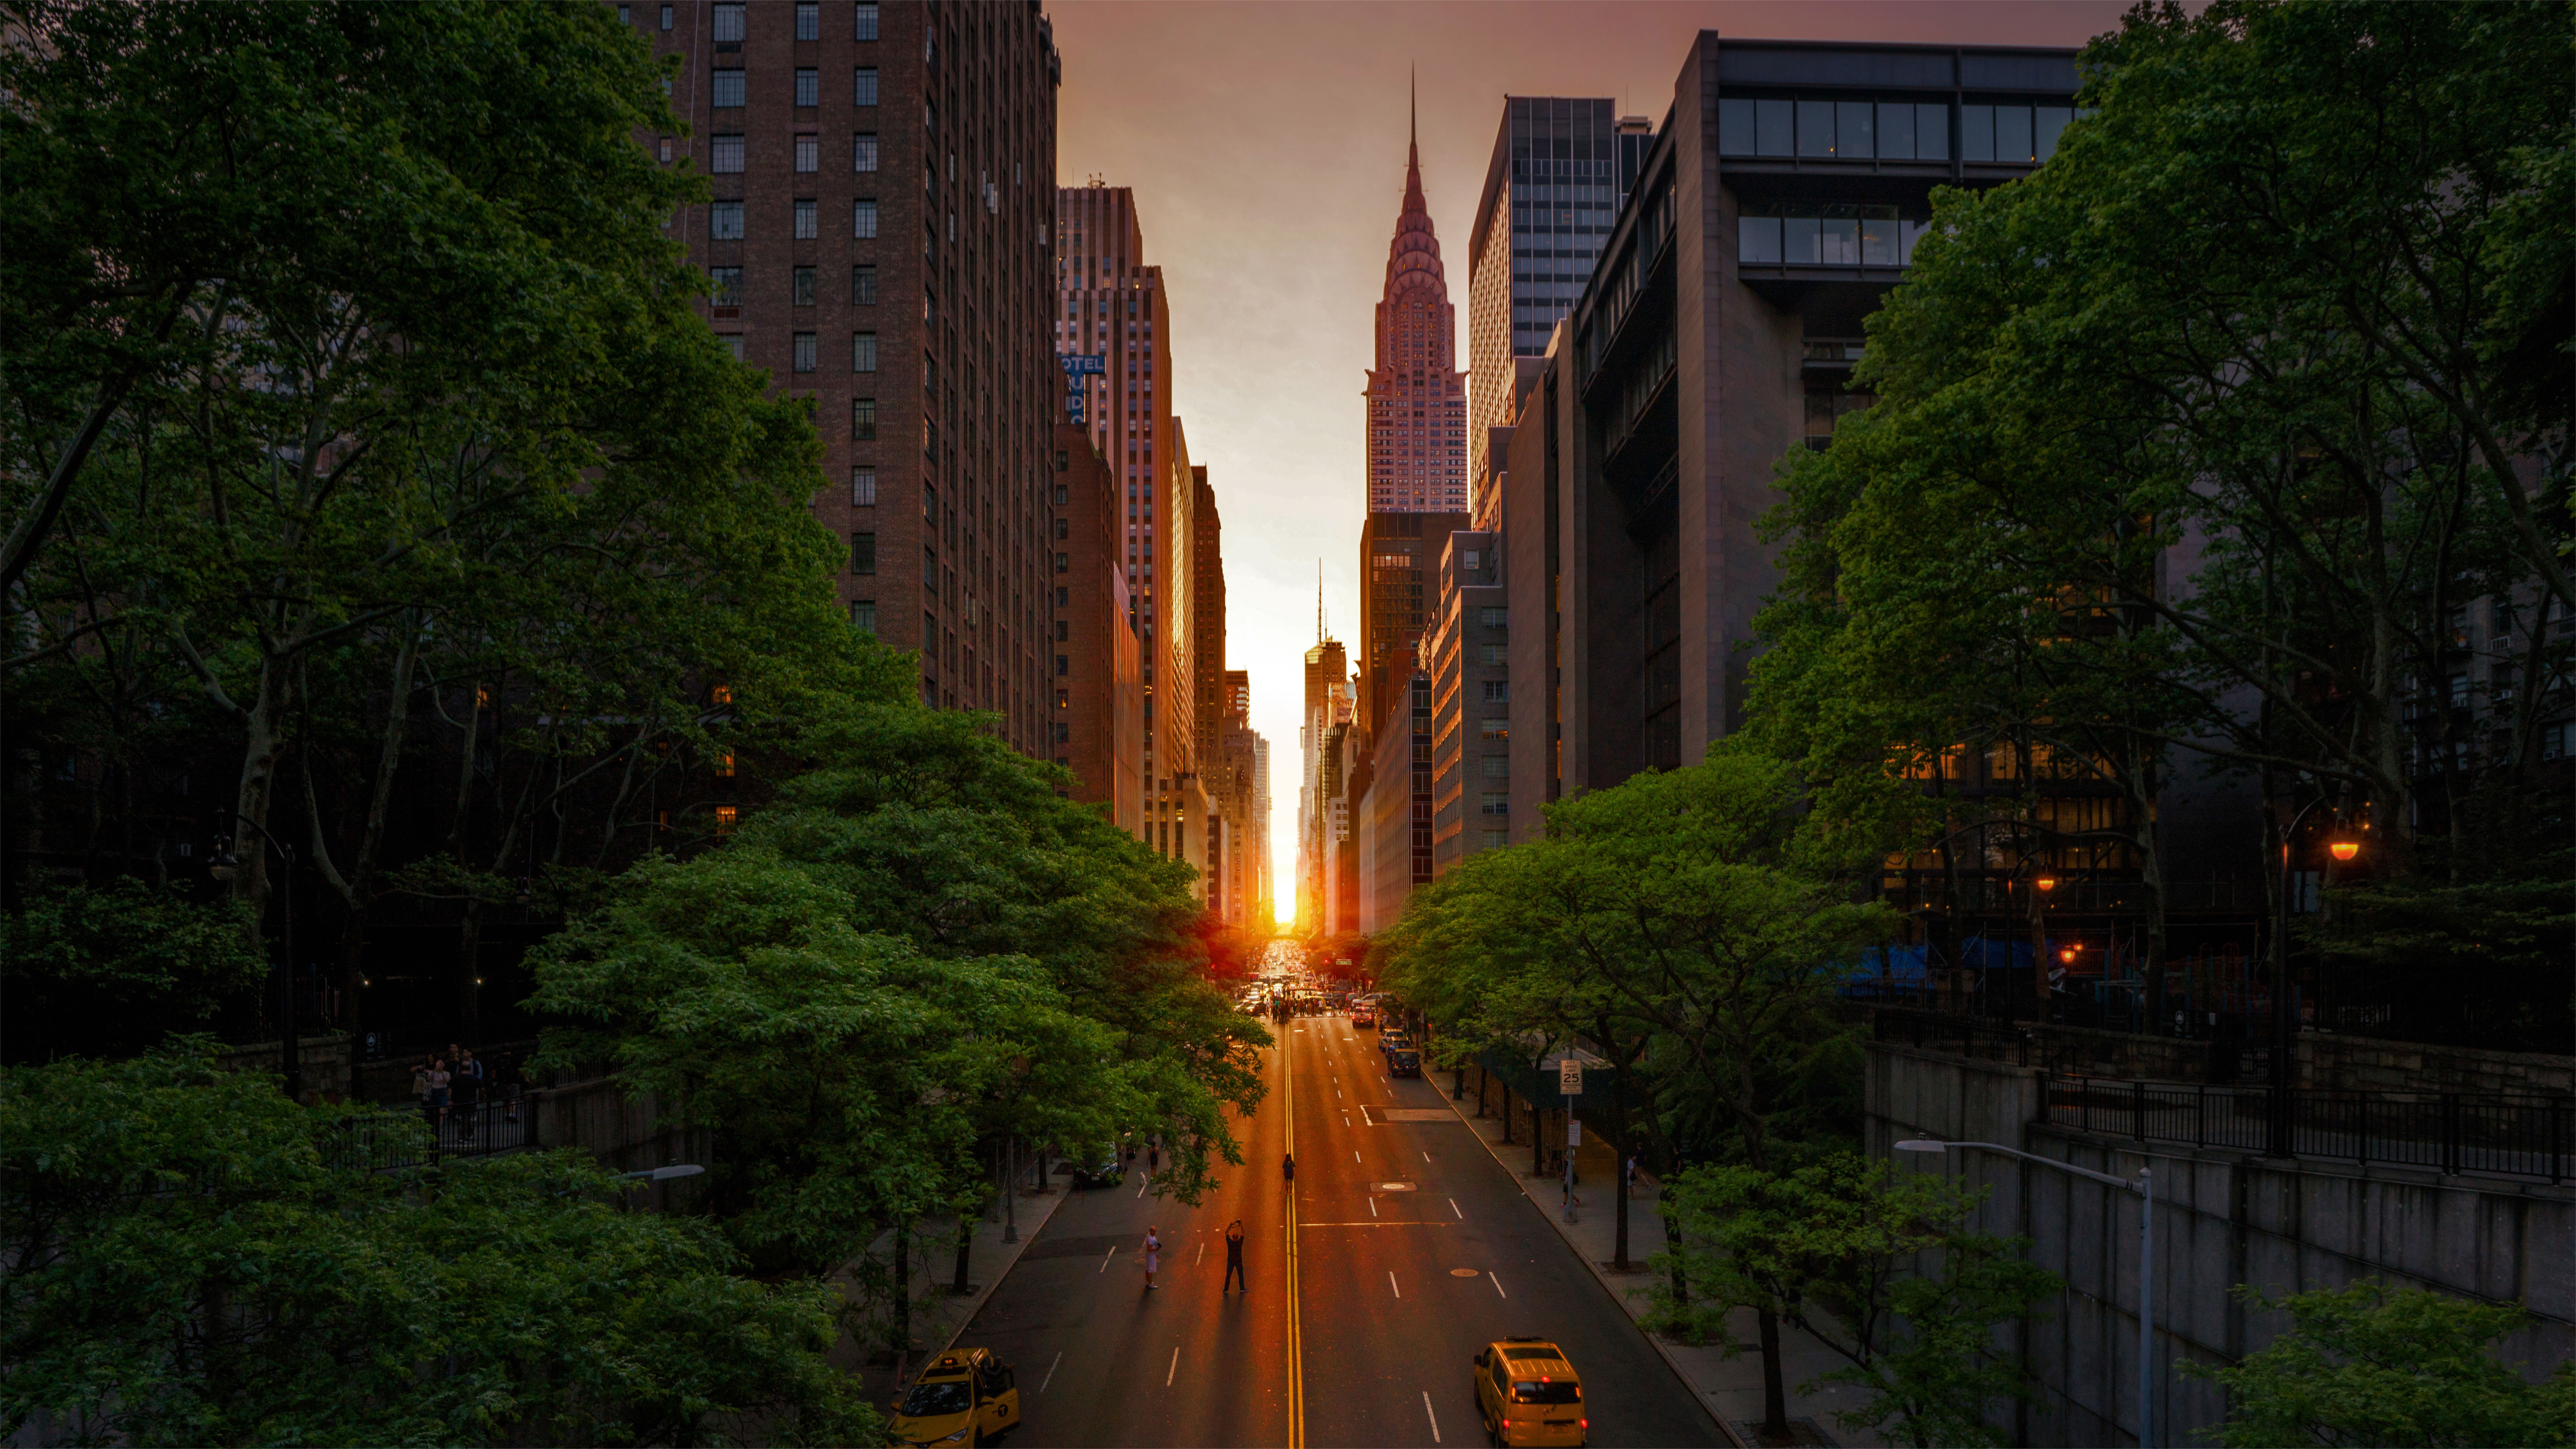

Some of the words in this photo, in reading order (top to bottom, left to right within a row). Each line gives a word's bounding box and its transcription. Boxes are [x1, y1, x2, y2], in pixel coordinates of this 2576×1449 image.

[1061, 357, 1103, 371] OTEL
[1071, 357, 1084, 424] TUDO
[1564, 1073, 1579, 1083] 25
